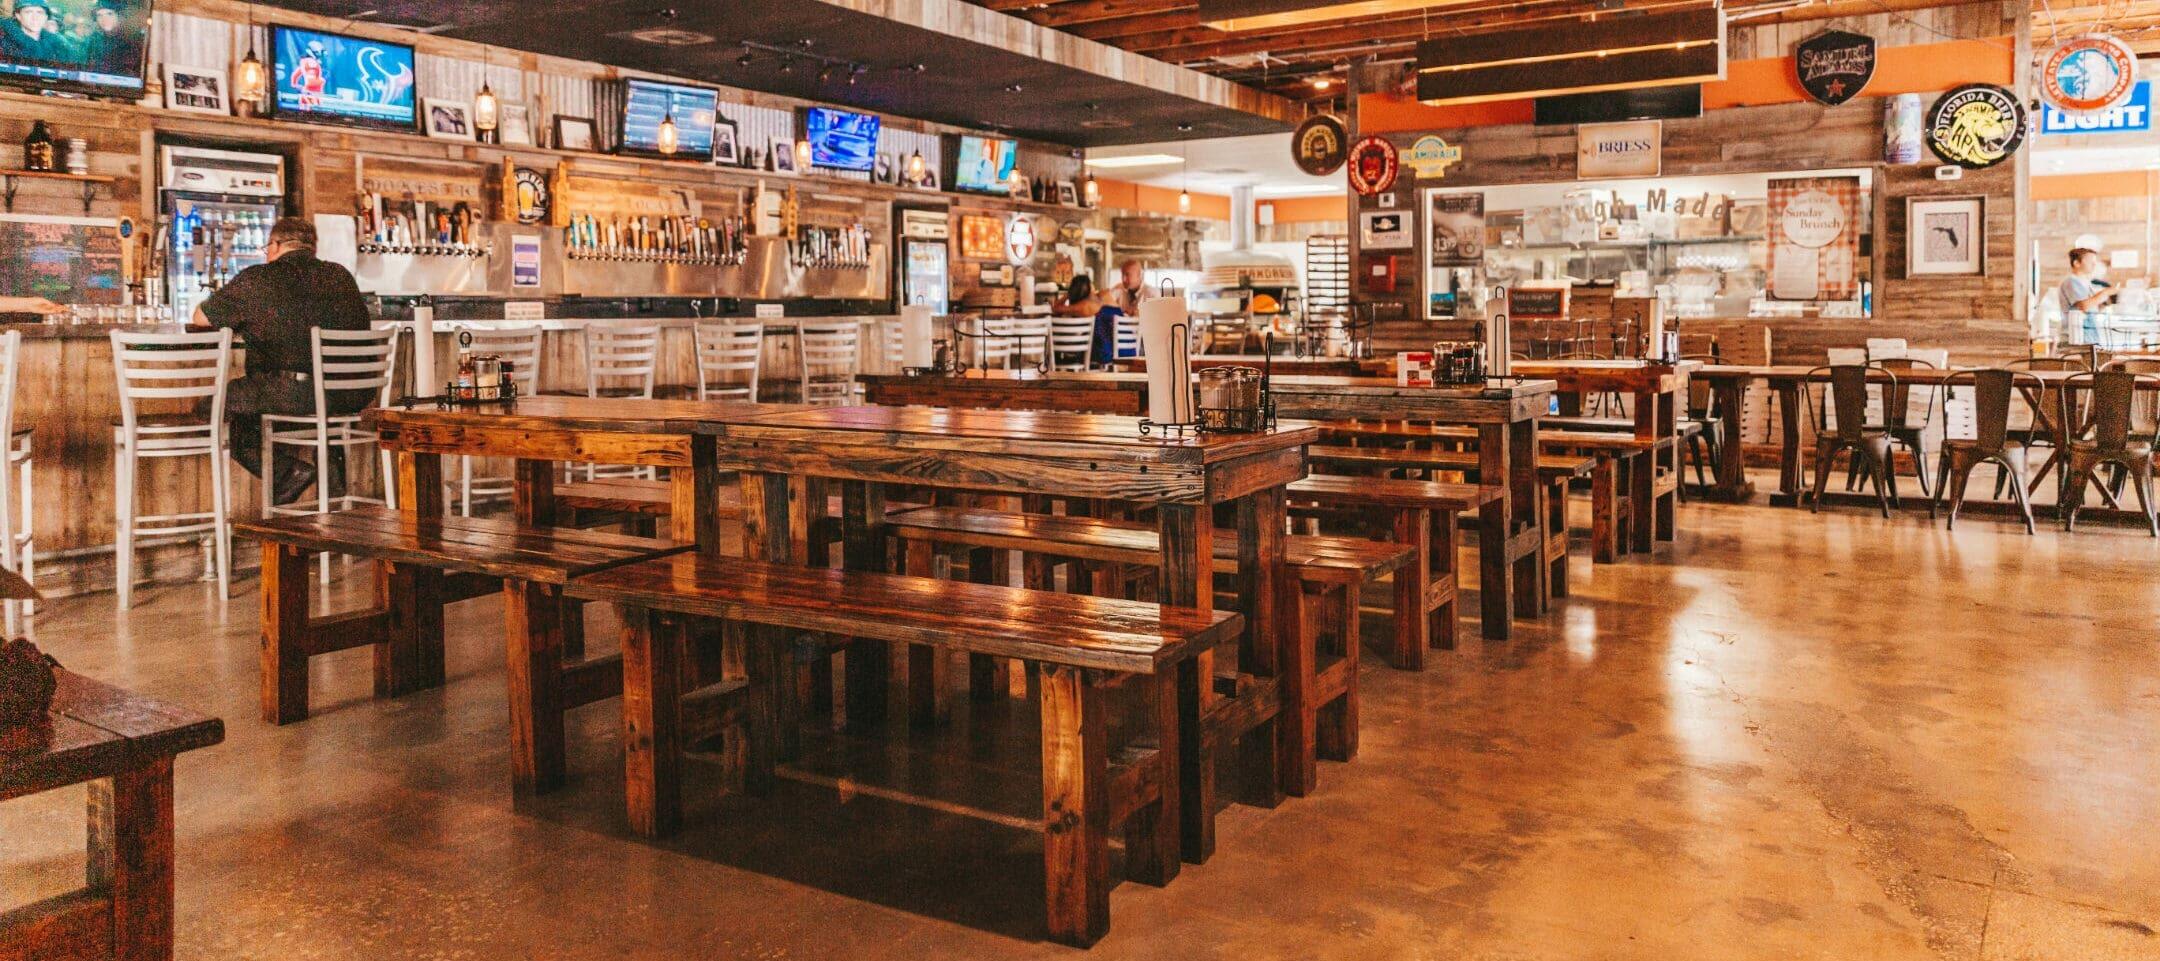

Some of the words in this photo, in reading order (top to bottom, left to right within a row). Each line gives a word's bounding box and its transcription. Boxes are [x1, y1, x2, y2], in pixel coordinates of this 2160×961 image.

[1801, 44, 1873, 68] SAMUEL
[1805, 60, 1867, 81] ADAMS
[2103, 56, 2130, 103] COMPANY
[1939, 92, 1986, 125] FLORIDA
[1988, 94, 2013, 120] BEER
[1599, 140, 1652, 153] BRIESS
[1550, 190, 1625, 228] ough
[1646, 187, 1725, 221] Made
[1786, 207, 1825, 218] Sunday
[1800, 217, 1840, 229] Brunch
